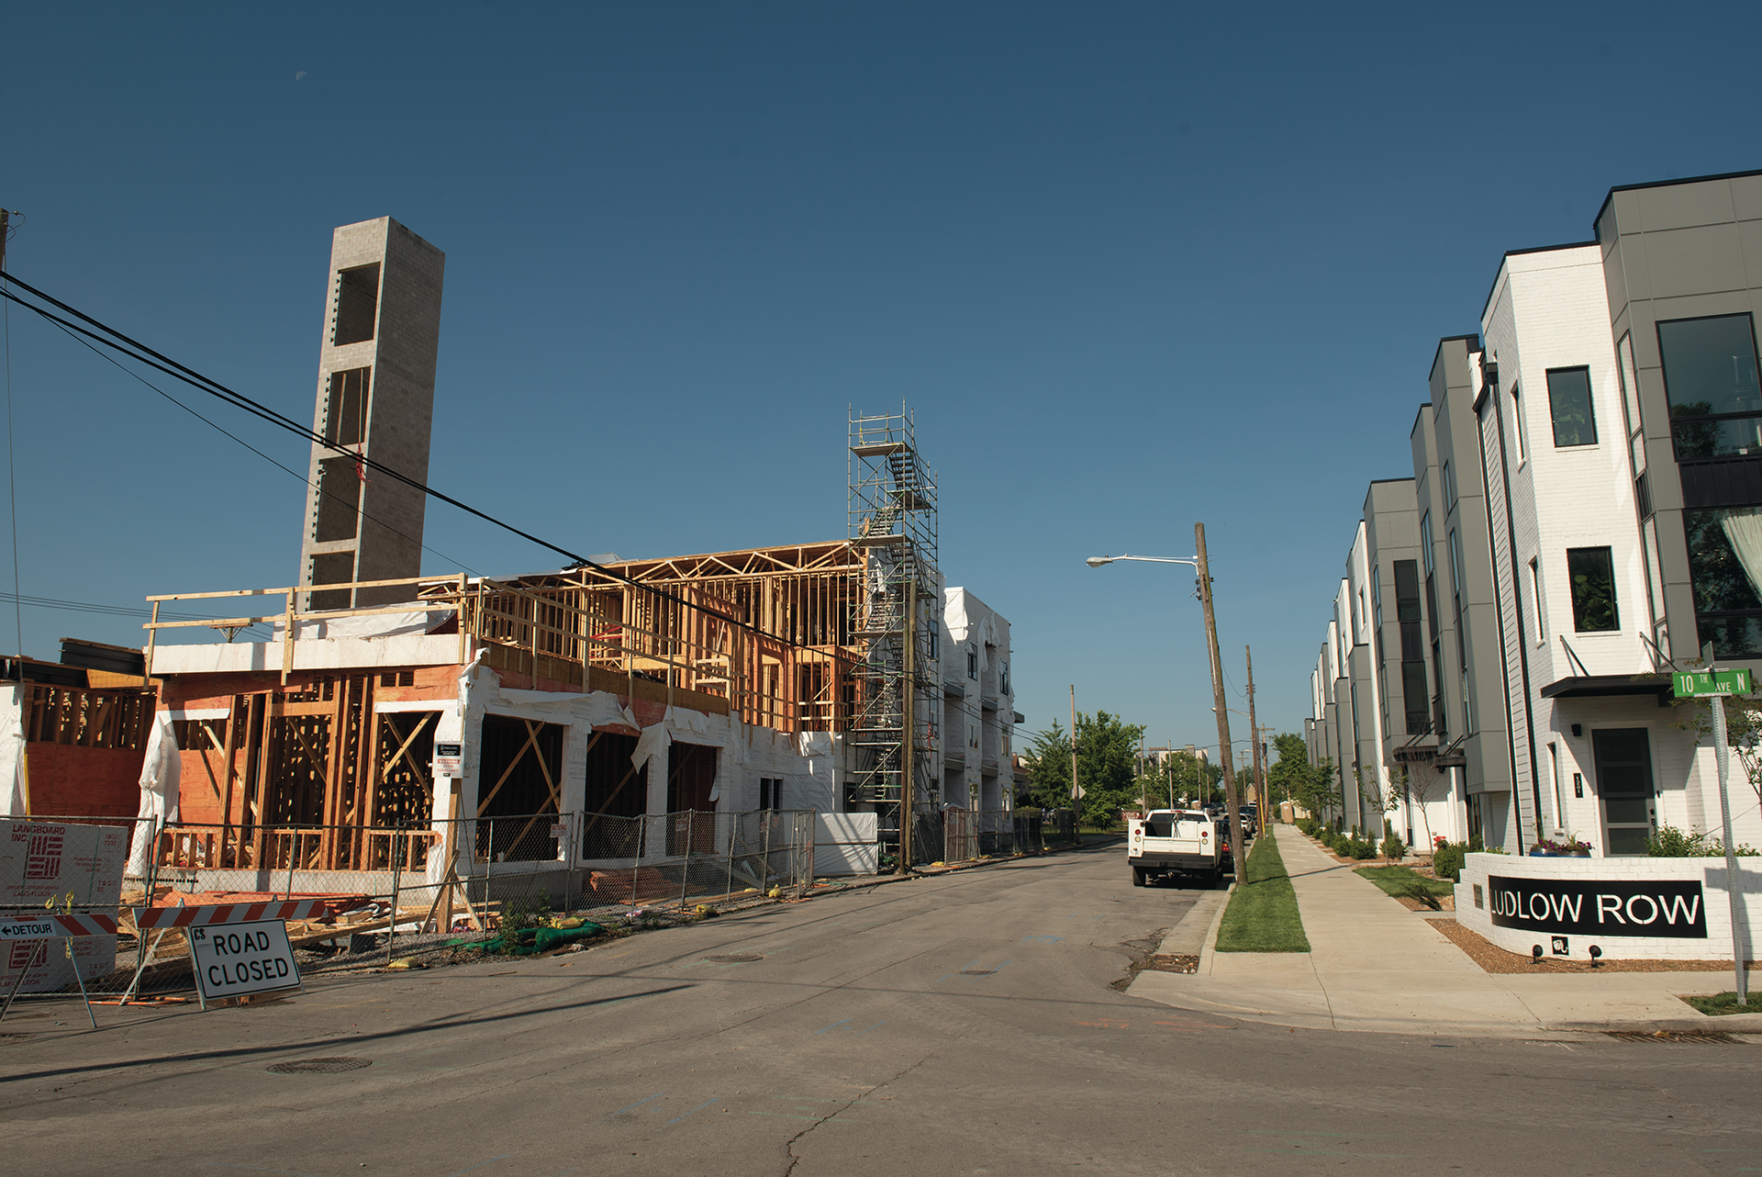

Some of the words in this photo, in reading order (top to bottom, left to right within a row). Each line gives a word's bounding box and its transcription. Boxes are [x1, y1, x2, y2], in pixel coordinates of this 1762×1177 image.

[1680, 674, 1694, 693] 10
[1699, 674, 1708, 684] TH
[1715, 682, 1732, 692] AVE
[1736, 673, 1746, 691] N
[1490, 888, 1584, 924] LUDLOW
[1596, 894, 1700, 925] ROW
[12, 924, 53, 935] DETOUR
[194, 928, 206, 940] CS
[212, 930, 270, 956] ROAD
[208, 957, 289, 987] CLOSED
